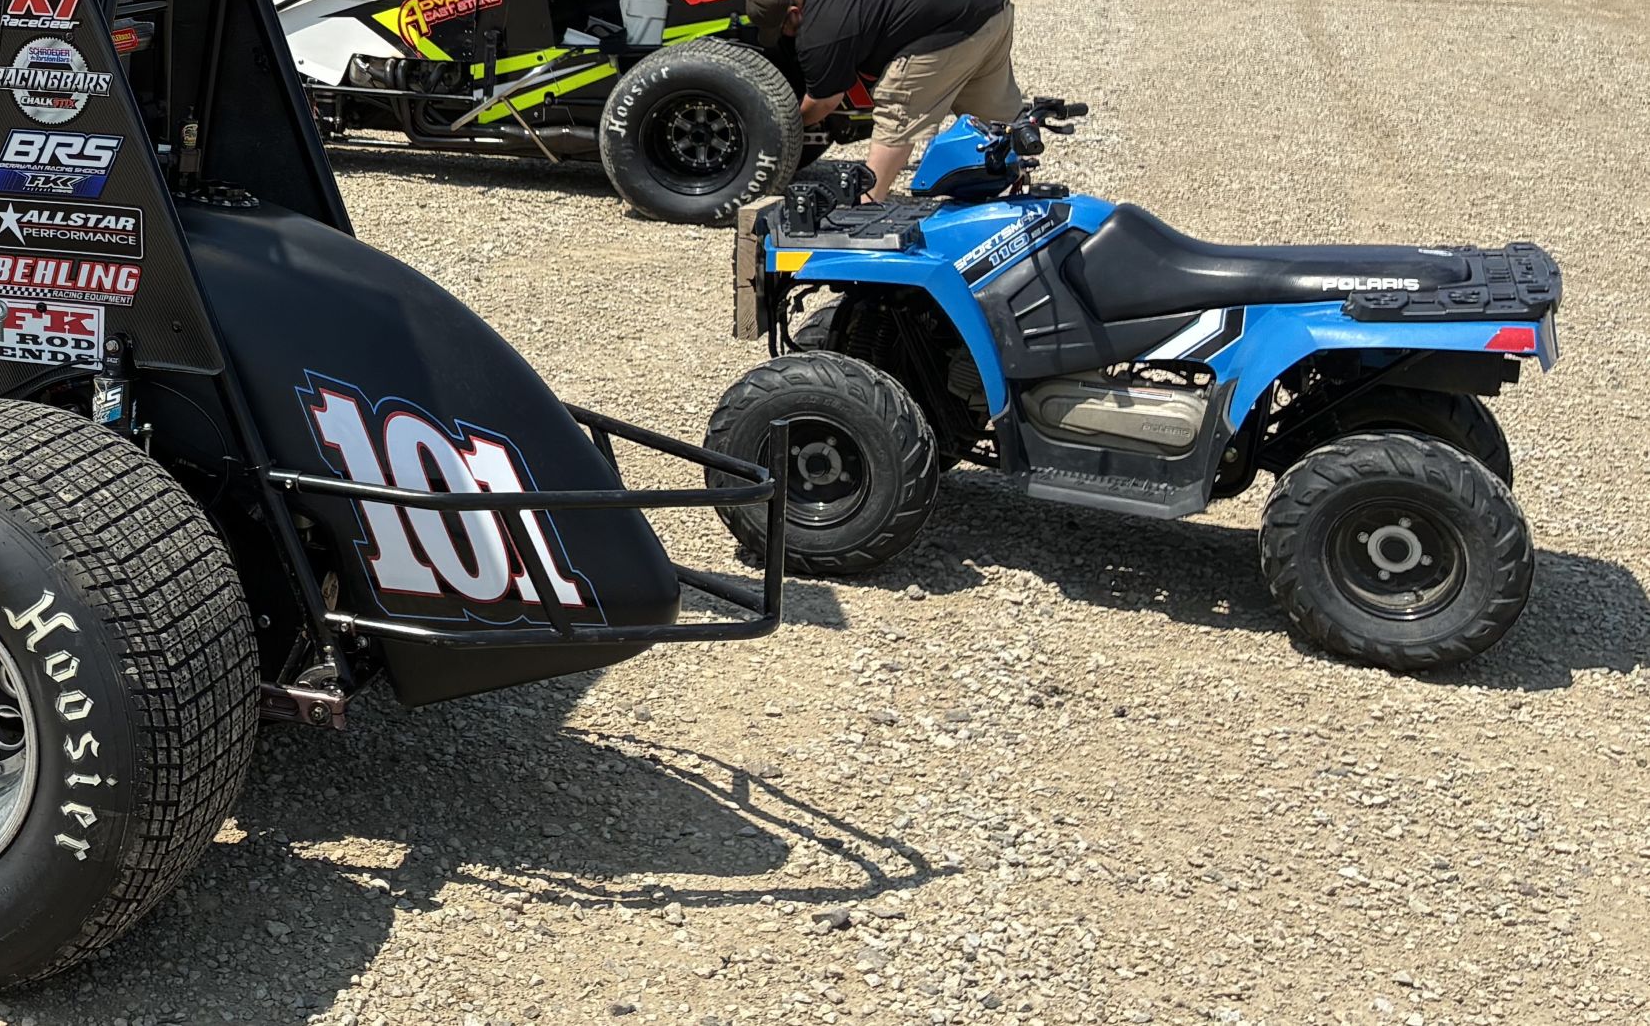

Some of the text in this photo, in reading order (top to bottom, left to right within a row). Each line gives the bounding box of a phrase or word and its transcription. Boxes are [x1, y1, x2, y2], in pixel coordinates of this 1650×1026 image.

[0, 14, 80, 30] RaceGear
[424, 4, 455, 23] CAST
[608, 66, 670, 139] Hoosier
[2, 131, 124, 169] BRS
[44, 165, 73, 173] RACING
[713, 149, 778, 220] Hoosier
[20, 209, 136, 231] ALLSTAR
[23, 227, 137, 246] PERFORMANCE
[953, 203, 1047, 271] SPORTSMAN
[988, 232, 1030, 267] 110
[52, 290, 131, 305] RACING EQUIPMENT
[1322, 277, 1420, 292] POLARIS
[3, 306, 95, 337] FK
[16, 332, 96, 351] ROD
[310, 388, 586, 609] 101
[1, 589, 119, 862] Hoosier
